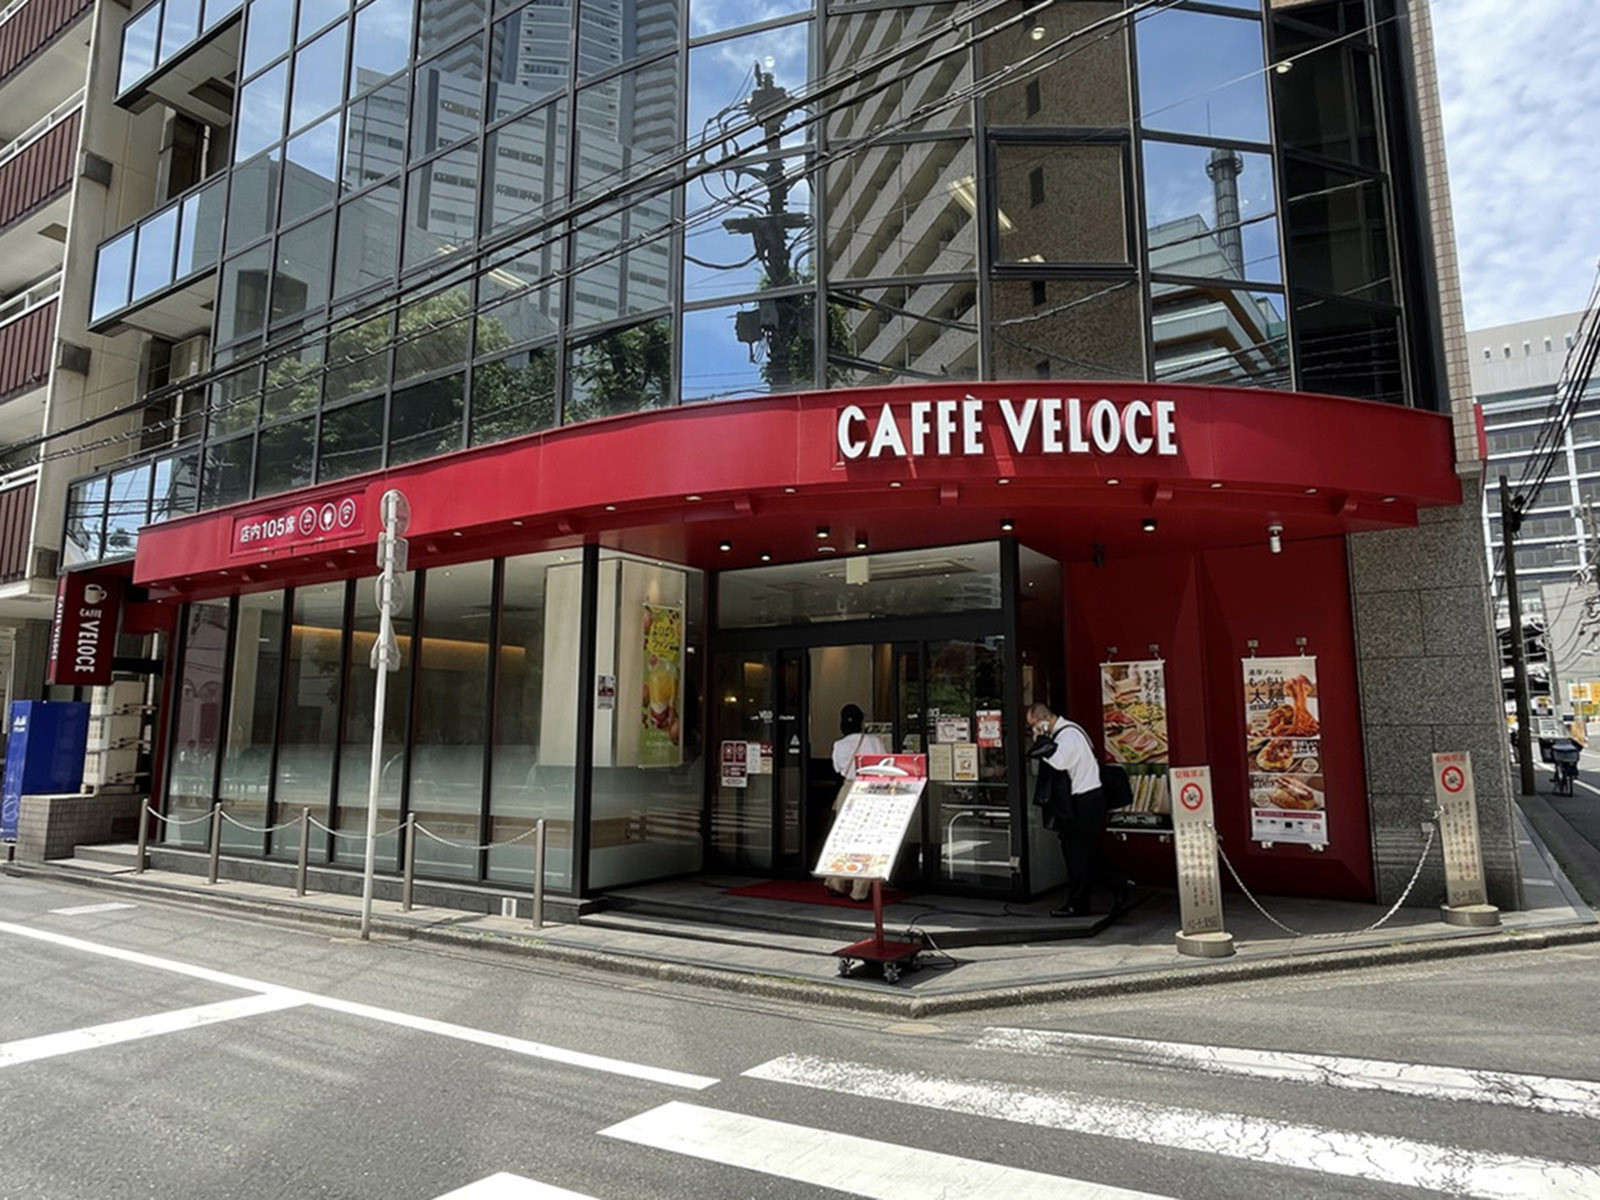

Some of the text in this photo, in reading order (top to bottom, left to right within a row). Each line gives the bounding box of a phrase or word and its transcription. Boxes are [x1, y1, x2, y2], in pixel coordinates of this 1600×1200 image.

[838, 394, 1178, 458] CAFFÈ VELOCE
[75, 620, 100, 673] VELOCE
